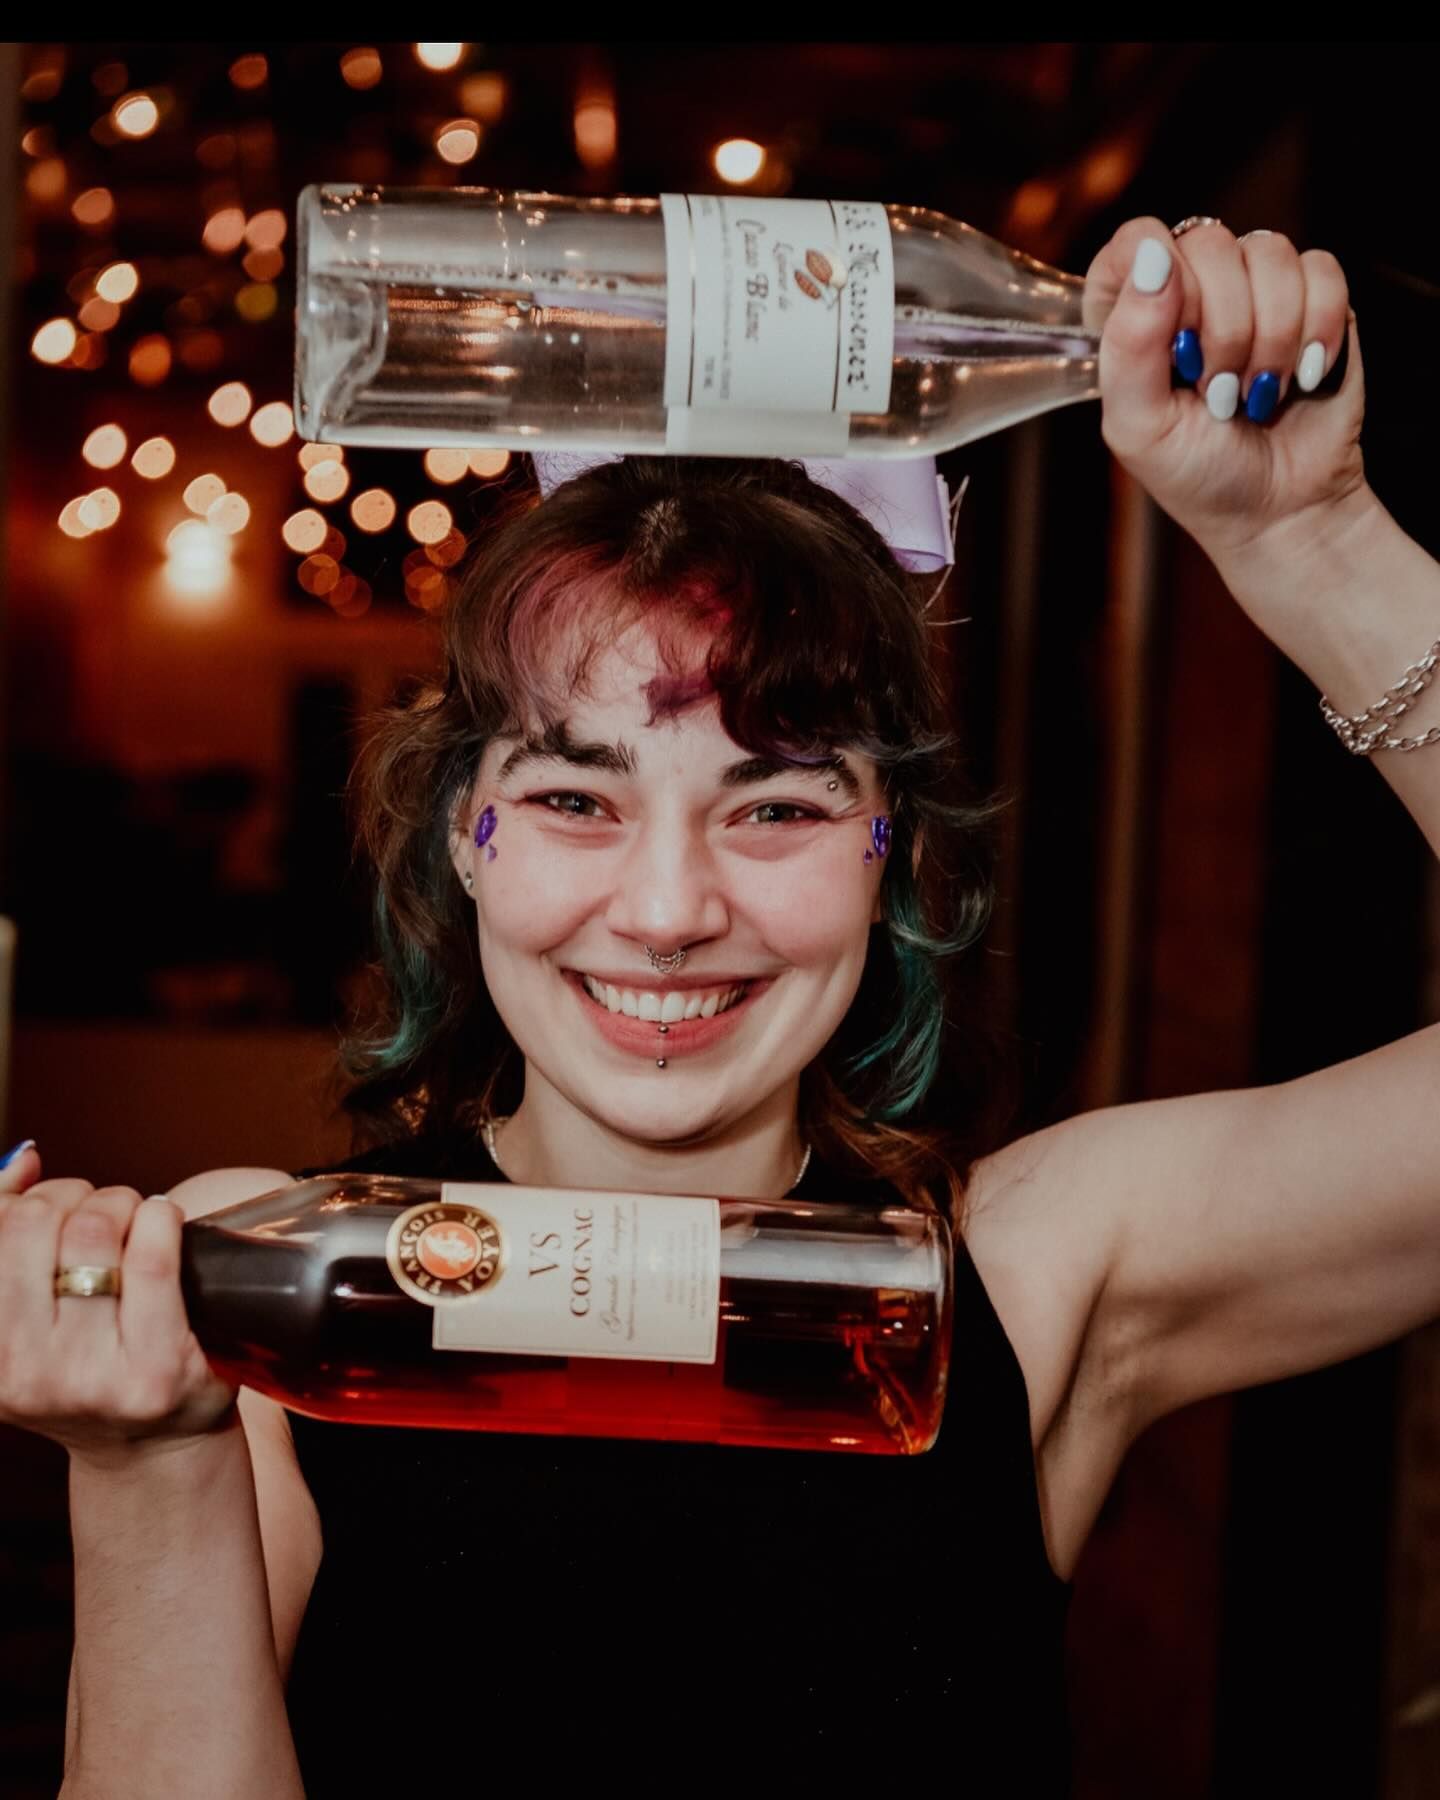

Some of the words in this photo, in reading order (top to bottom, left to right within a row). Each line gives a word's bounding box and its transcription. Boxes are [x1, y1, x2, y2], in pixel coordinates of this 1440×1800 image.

[400, 1209, 446, 1295] FRANÇOIS
[457, 1212, 501, 1293] VOYER
[528, 1231, 562, 1278] VS
[570, 1208, 593, 1318] COGNAC
